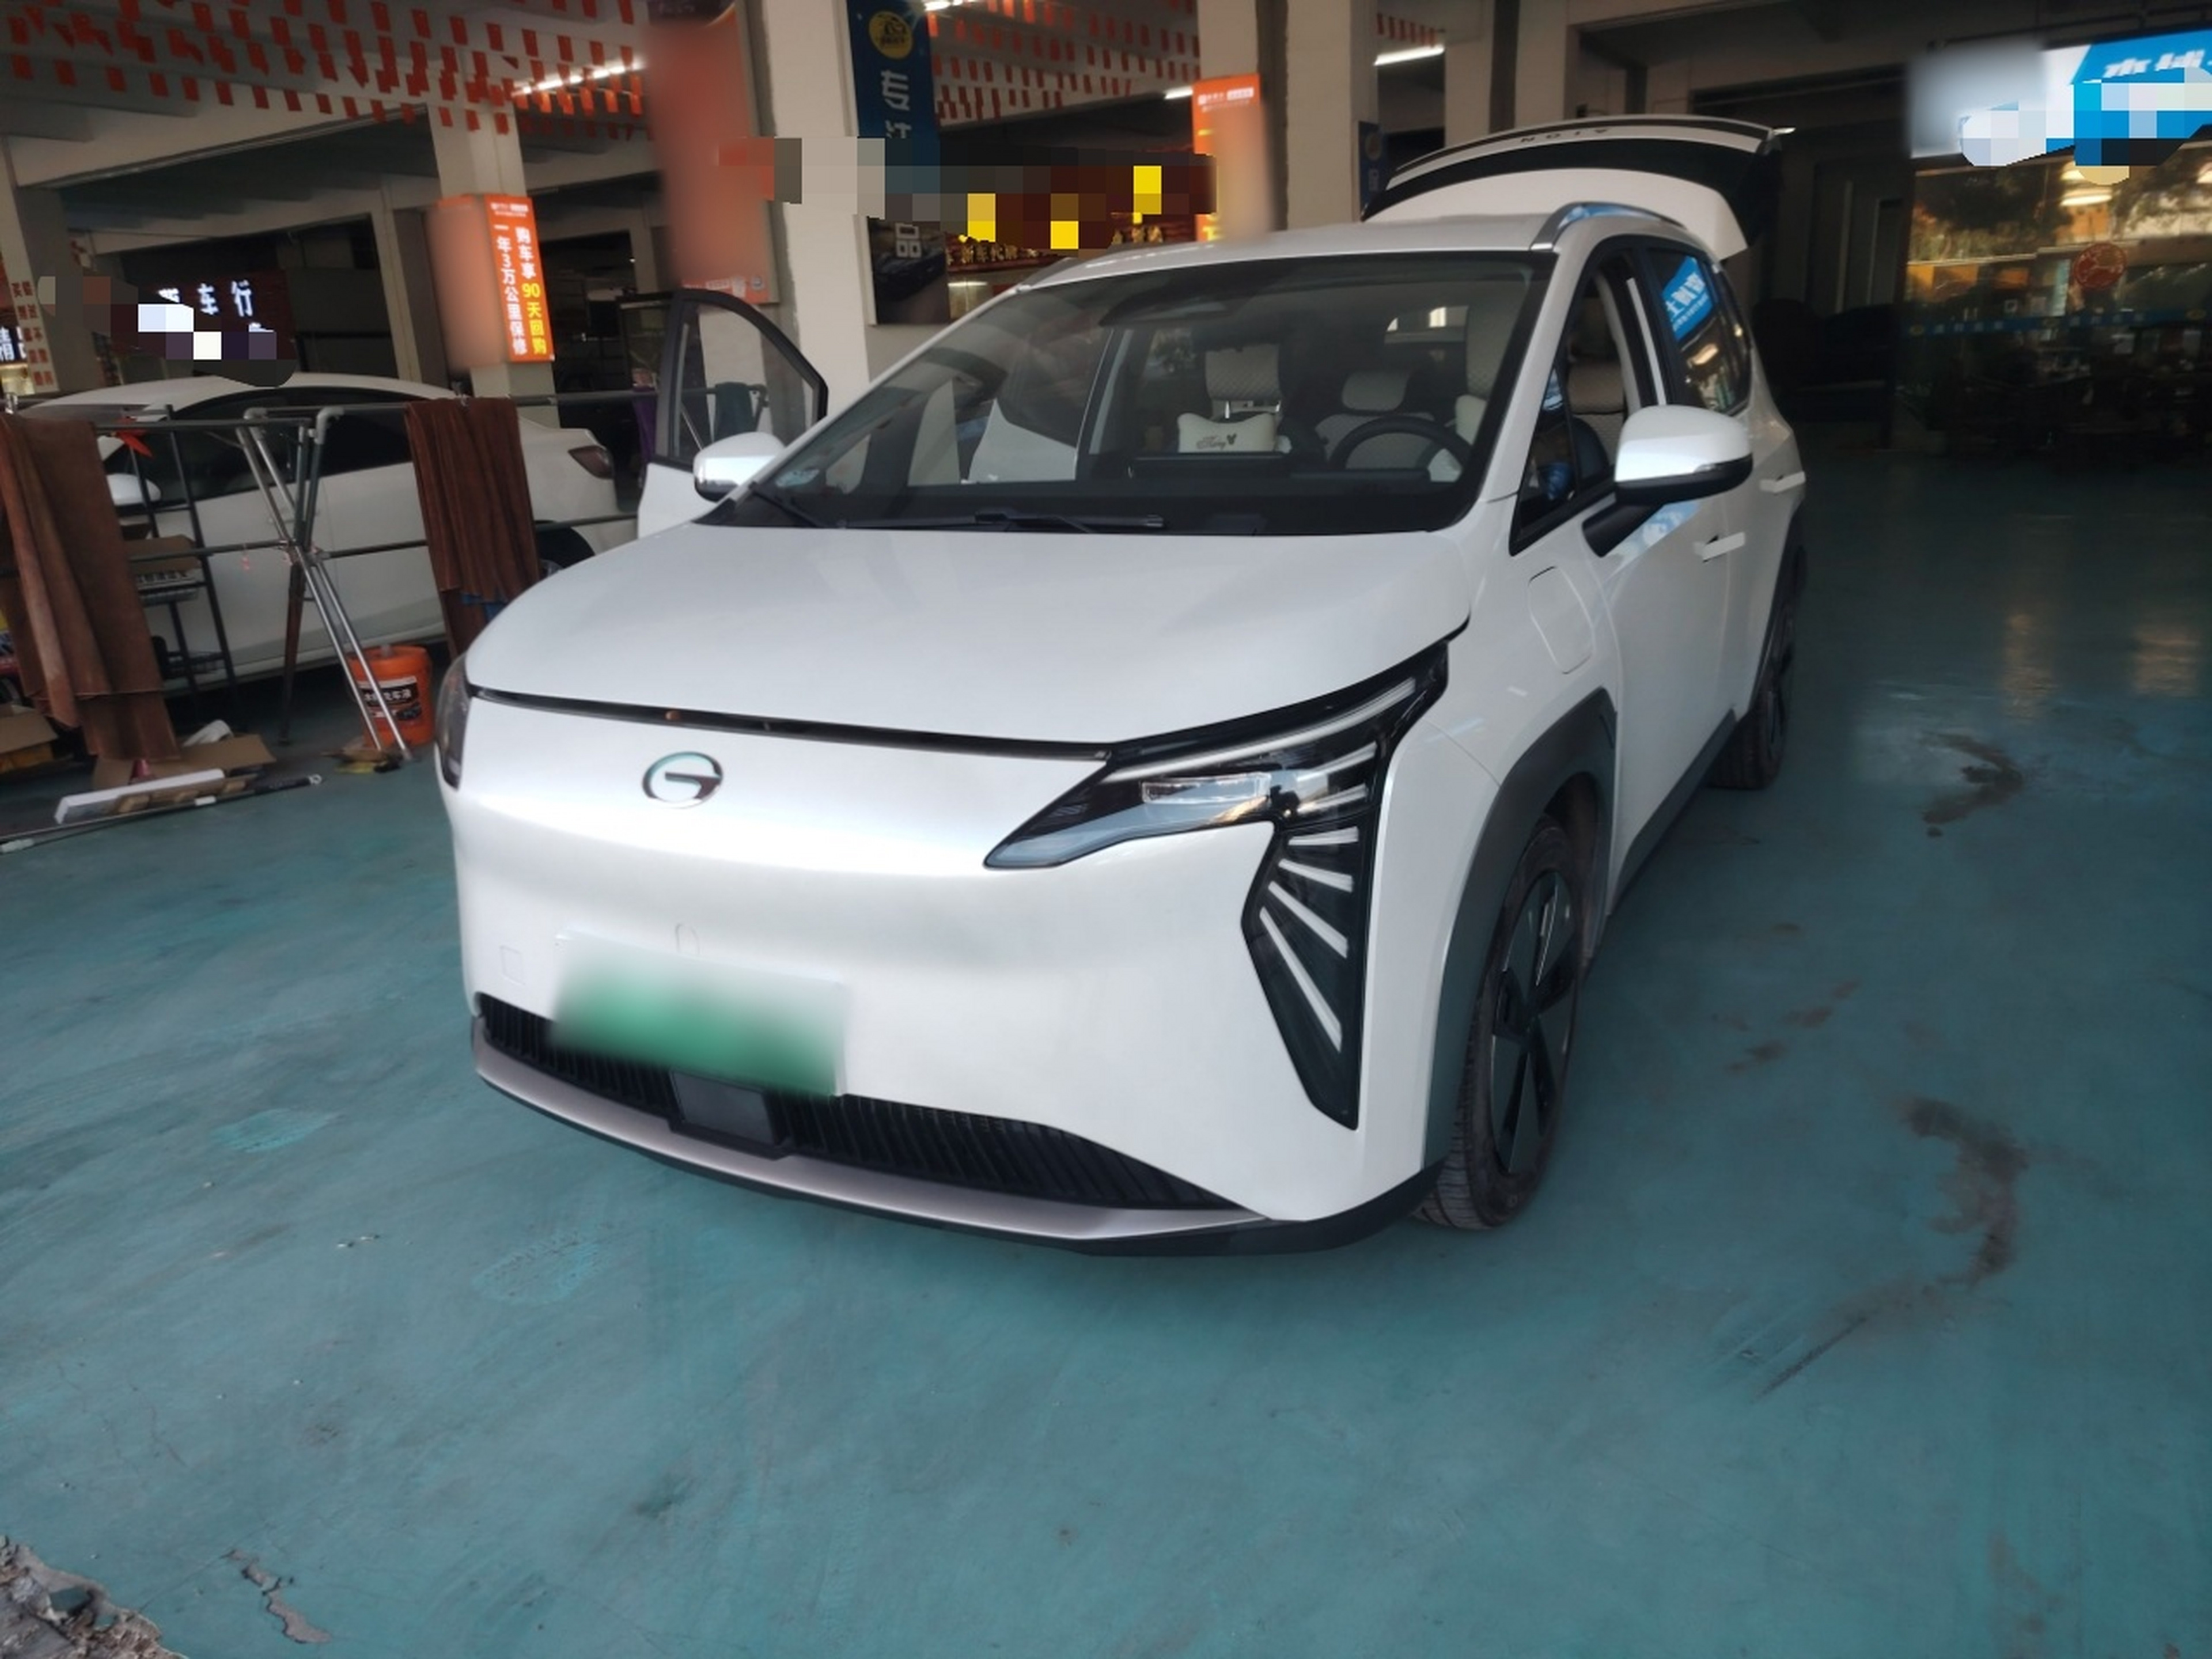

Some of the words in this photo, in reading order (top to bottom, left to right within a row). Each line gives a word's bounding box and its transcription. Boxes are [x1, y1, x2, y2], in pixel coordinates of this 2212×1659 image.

[494, 224, 528, 355] 一年3万公里保修
[515, 226, 547, 355] 购车享90天回购
